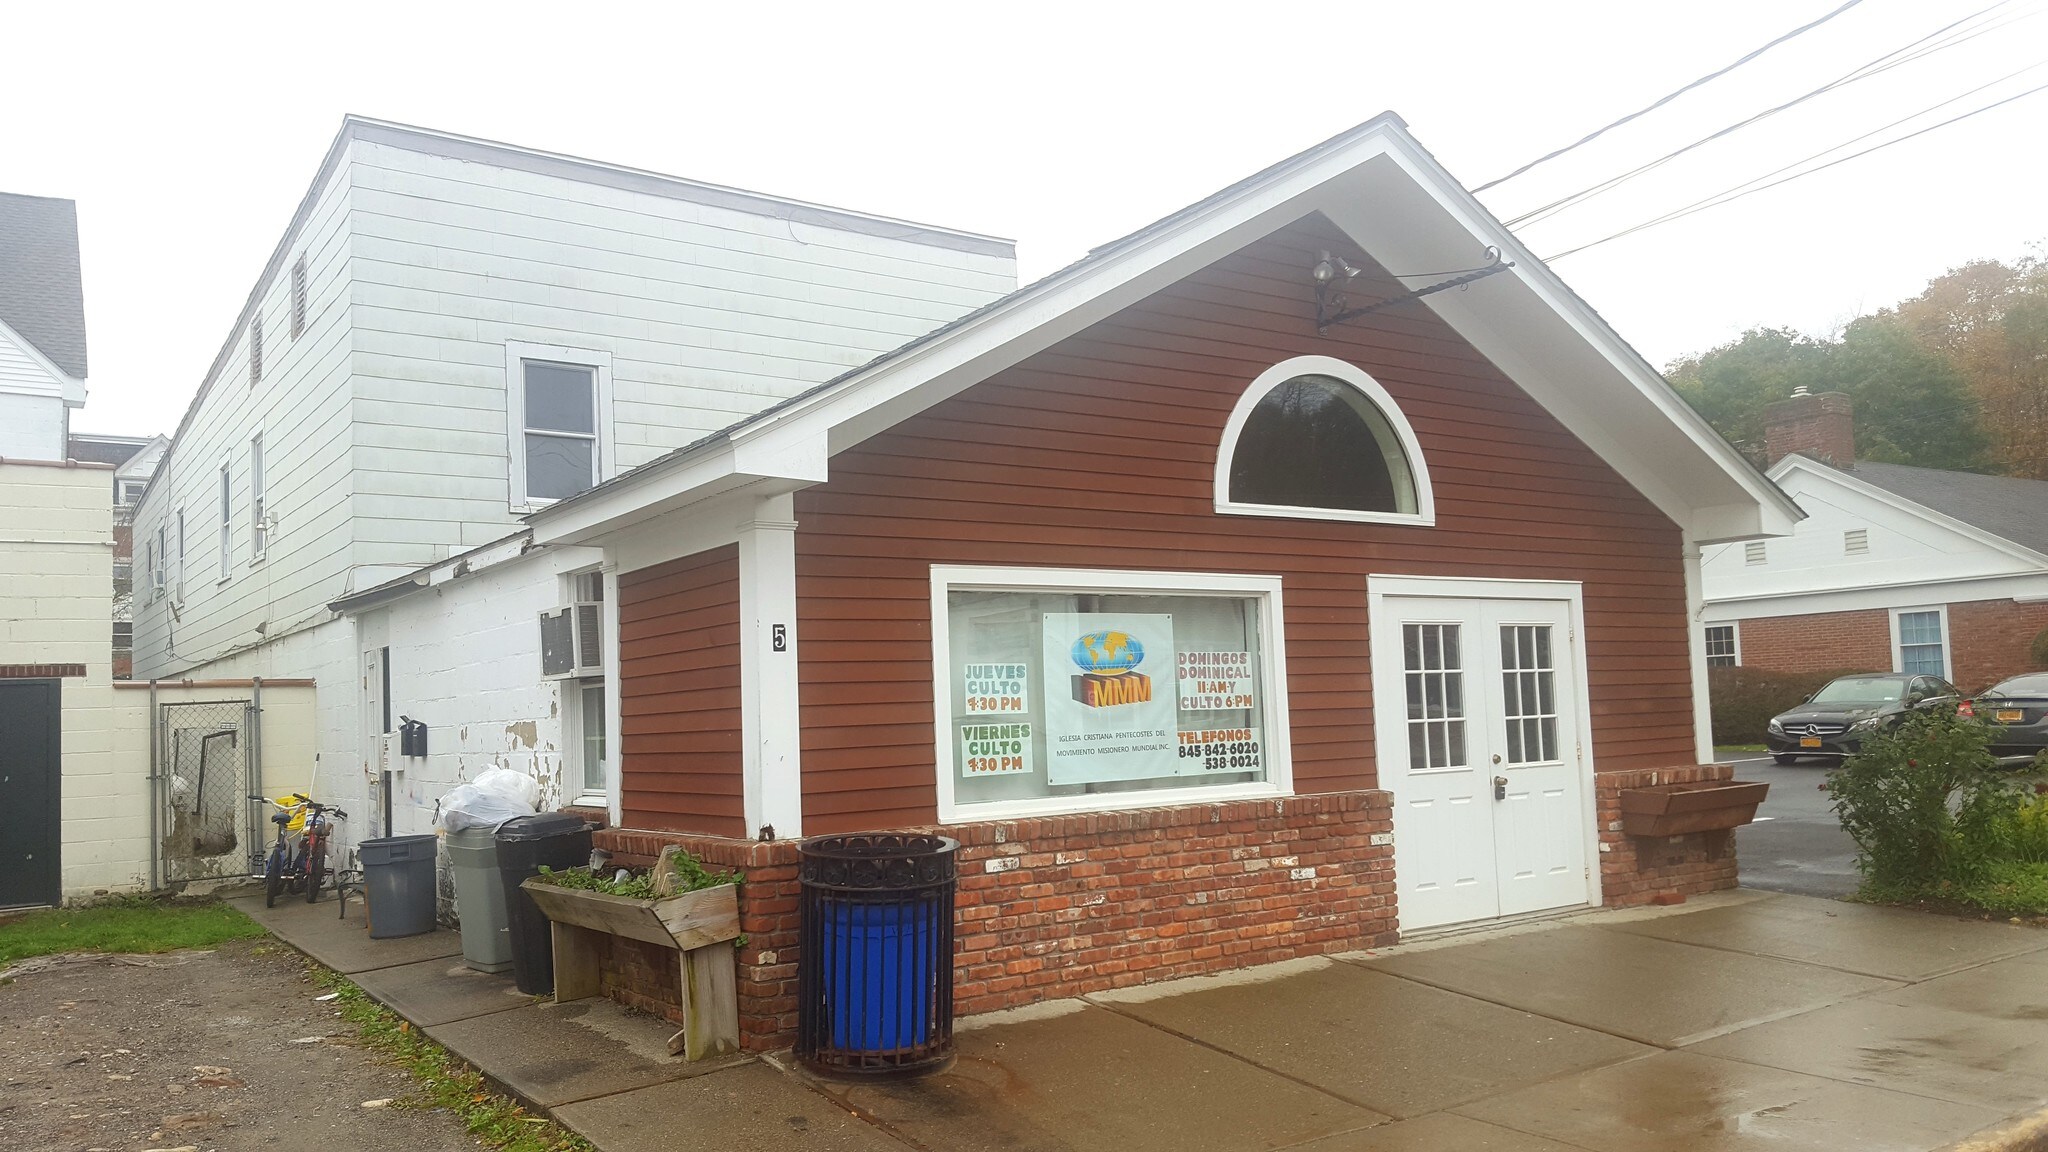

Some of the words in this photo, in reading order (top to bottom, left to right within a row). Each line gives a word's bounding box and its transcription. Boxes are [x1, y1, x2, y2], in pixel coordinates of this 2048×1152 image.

[774, 626, 786, 649] 5
[1178, 652, 1247, 665] DOMINGOS
[965, 665, 1025, 679] JUEVES
[1180, 666, 1251, 679] DOMINICAL
[967, 681, 1021, 694] CULTO
[1092, 674, 1152, 708] MMM
[967, 696, 997, 711] 7:30
[1000, 697, 1022, 711] PM
[1181, 696, 1223, 709] CULTO
[962, 724, 1031, 740] VIERNES
[1083, 733, 1113, 741] CRISTIANA
[1115, 730, 1153, 739] PENTECOSTES
[1155, 729, 1166, 737] DEL
[1177, 729, 1252, 744] TELEFONOS
[968, 741, 1022, 756] CULTO
[1056, 748, 1096, 757] MOVIMIENTO
[1097, 745, 1130, 754] MISIONERO
[1131, 744, 1158, 752] MUNDIAL
[1178, 742, 1259, 758] 845-842-6020
[967, 757, 997, 772] 7:30
[1001, 756, 1023, 771] PM
